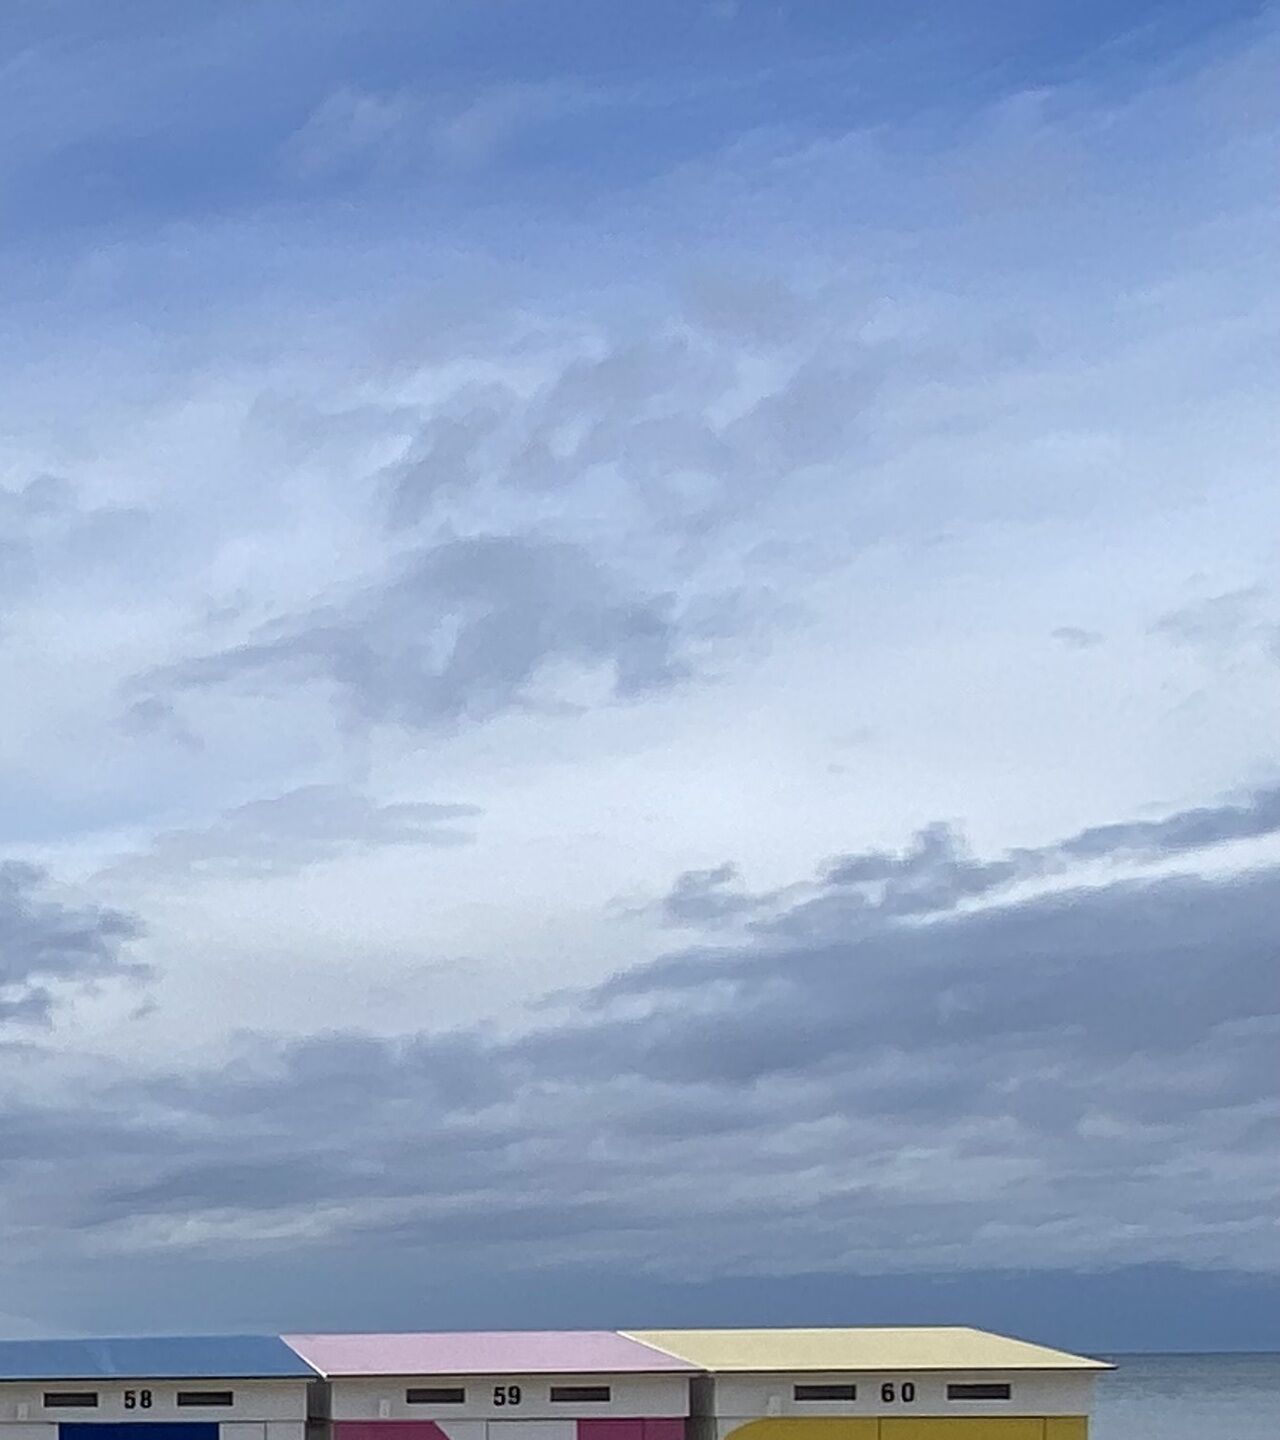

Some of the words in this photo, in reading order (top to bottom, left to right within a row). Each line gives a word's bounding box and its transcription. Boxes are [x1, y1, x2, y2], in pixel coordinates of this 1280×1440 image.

[124, 1390, 153, 1409] 58
[494, 1386, 520, 1406] 59
[882, 1383, 914, 1403] 60
